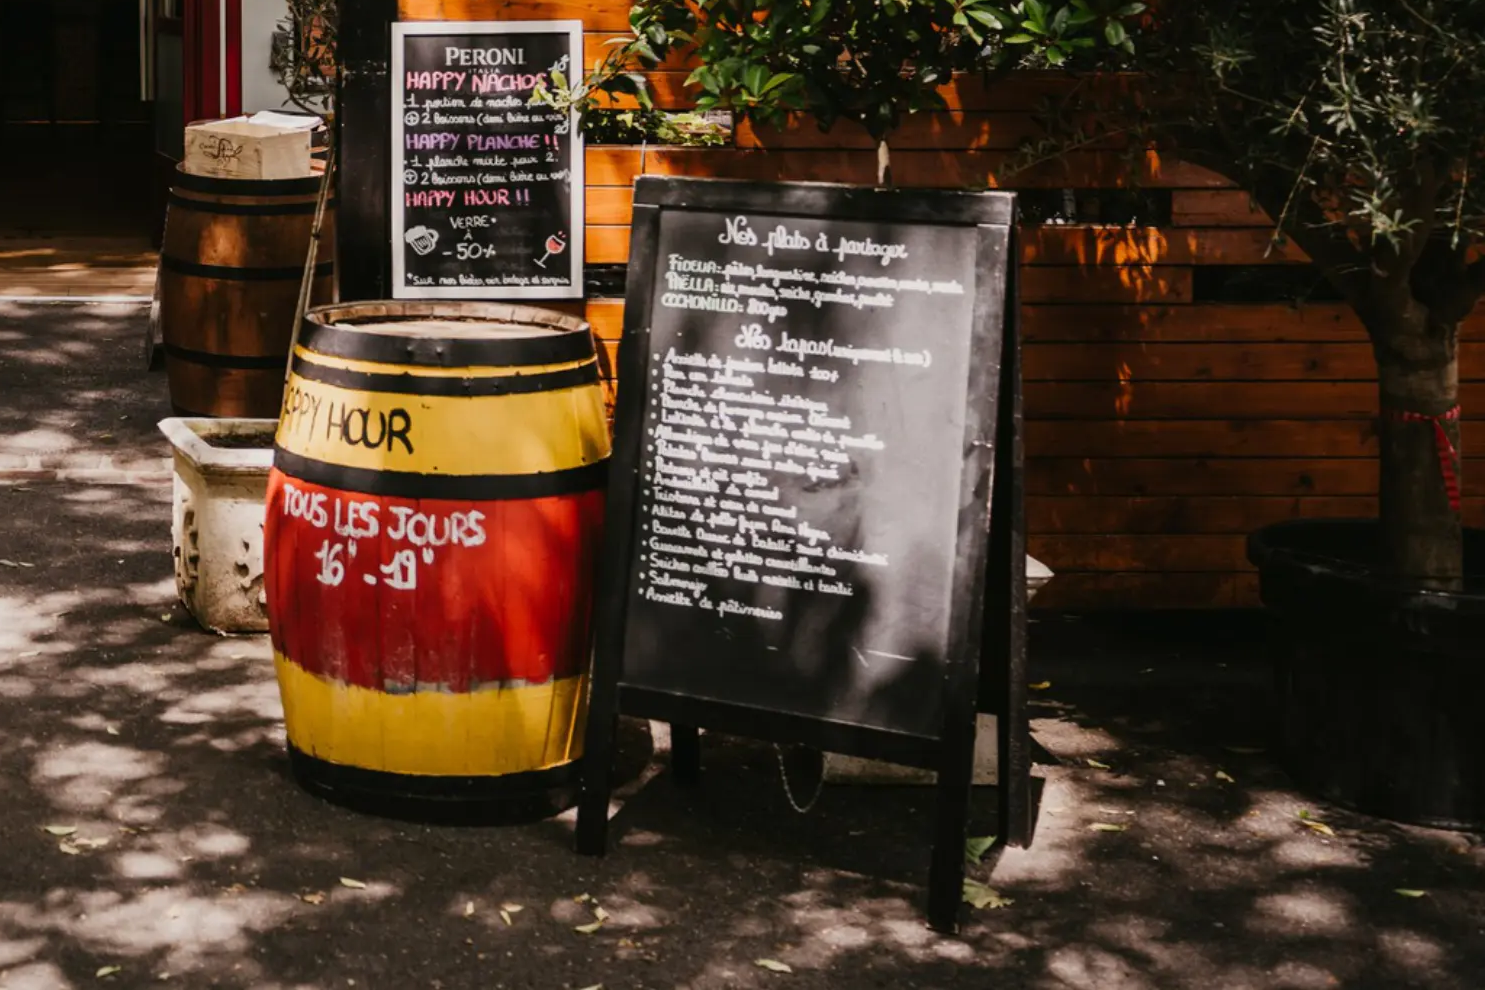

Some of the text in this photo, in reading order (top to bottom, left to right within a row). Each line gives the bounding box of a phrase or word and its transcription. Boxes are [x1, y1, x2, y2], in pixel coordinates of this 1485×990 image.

[445, 47, 525, 66] PERONI
[406, 71, 547, 95] HAPPY NACHOS
[422, 96, 465, 112] portion
[470, 96, 483, 107] de
[486, 94, 522, 107] nachos
[421, 111, 430, 124] 2
[434, 111, 475, 124] boissons
[405, 132, 461, 151] HAPPY
[467, 133, 541, 151] PLANCHE
[425, 154, 469, 170] planche
[472, 156, 508, 167] mixte
[510, 157, 539, 168] pour
[421, 173, 430, 185] 2
[431, 172, 476, 185] boissons
[405, 190, 456, 207] HAPPY
[464, 188, 511, 207] HOUR
[718, 215, 909, 266] Nos plats à partager
[456, 242, 497, 260] 50%
[734, 323, 772, 350] Nos
[326, 401, 415, 456] HOUR
[283, 483, 487, 548] TOUS LES JOURS
[699, 596, 713, 609] de
